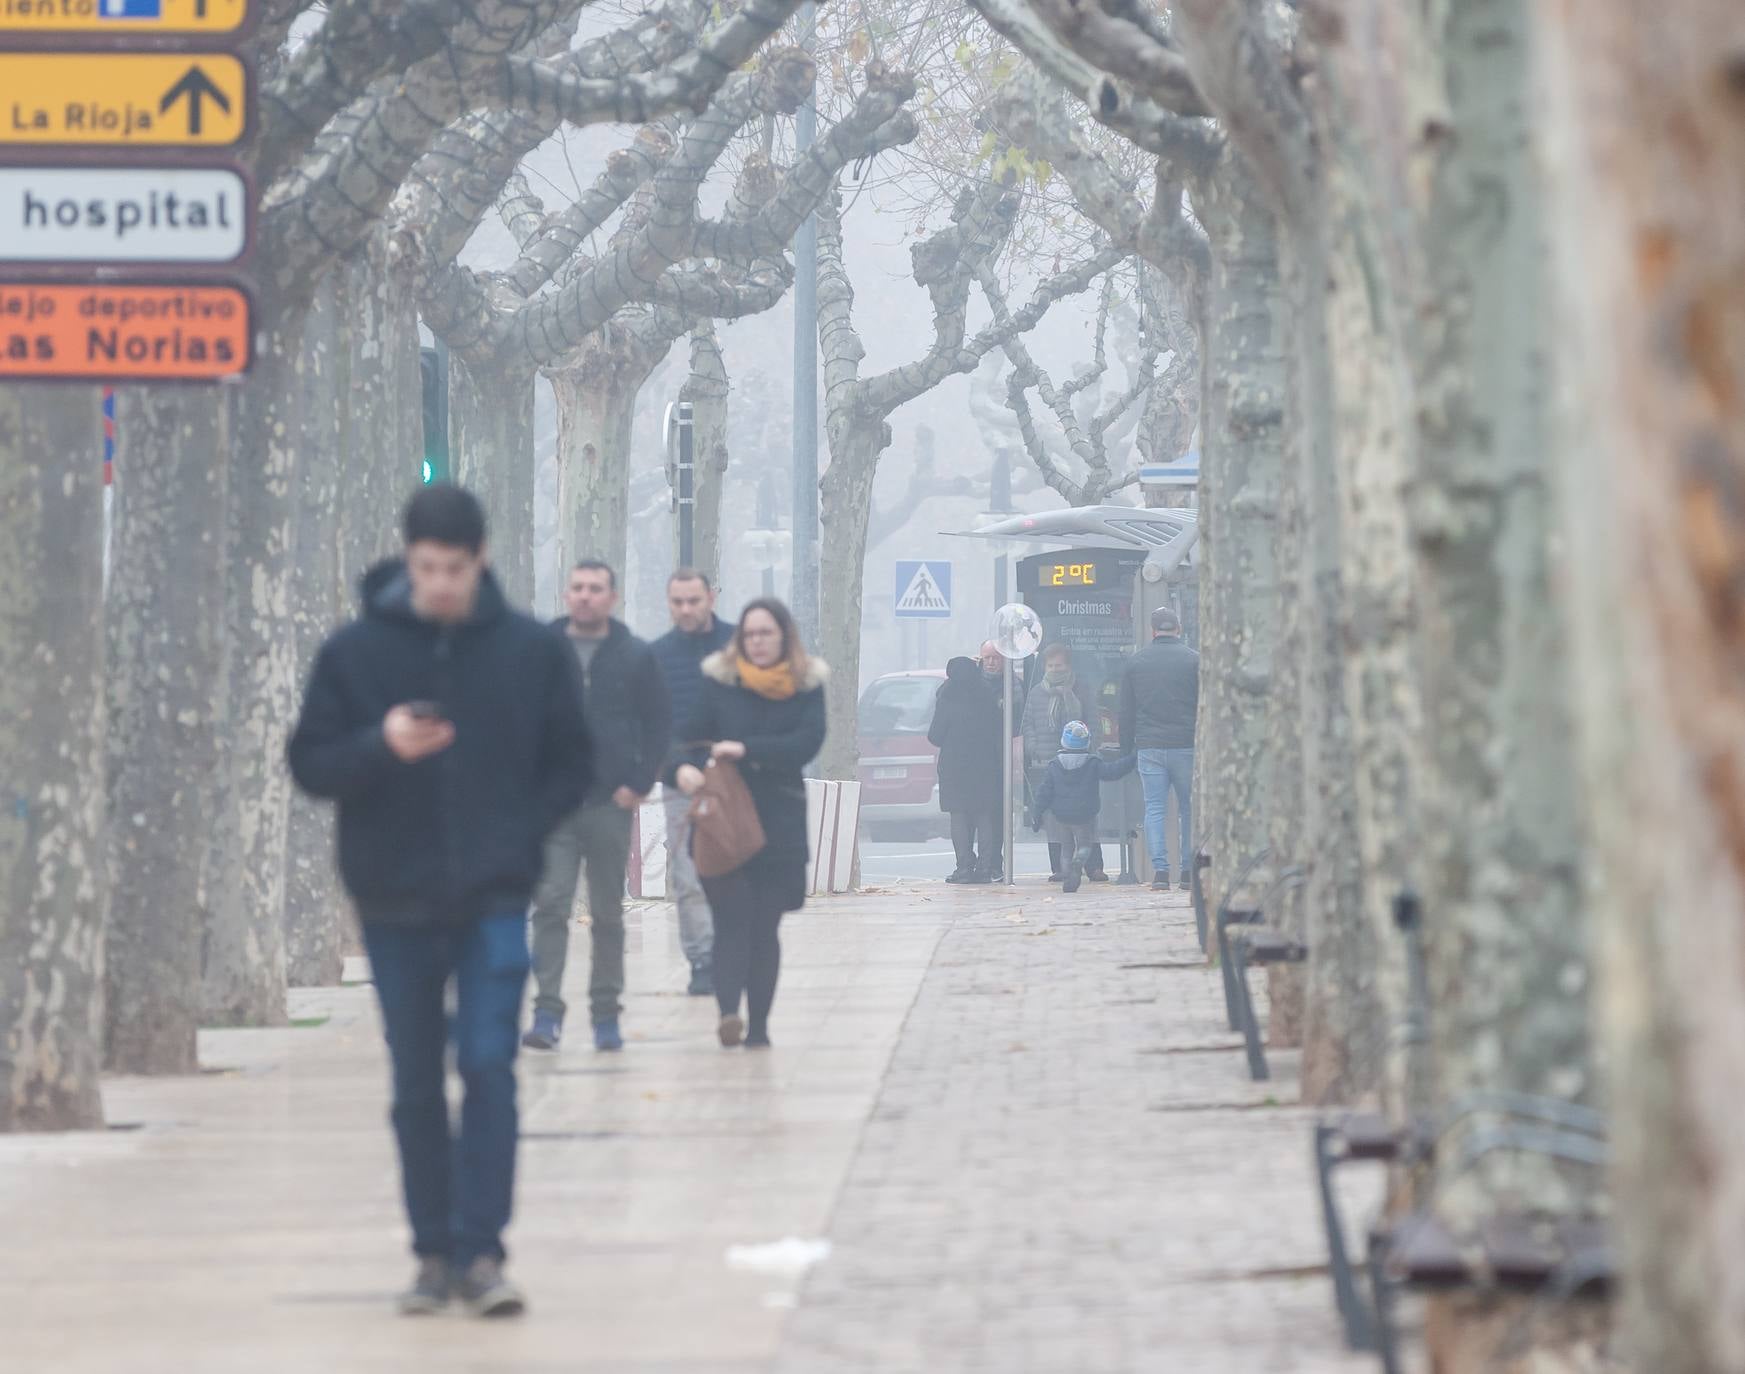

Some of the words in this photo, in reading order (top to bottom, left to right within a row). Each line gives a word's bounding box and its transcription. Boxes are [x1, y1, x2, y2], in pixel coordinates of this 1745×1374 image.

[0, 0, 94, 17] iento
[12, 102, 50, 129] La
[65, 102, 153, 136] Rioja
[23, 189, 232, 236] hospital
[78, 289, 236, 321] deportivo
[0, 333, 54, 361] as
[87, 327, 234, 362] Norias
[1058, 600, 1112, 615] Christmas
